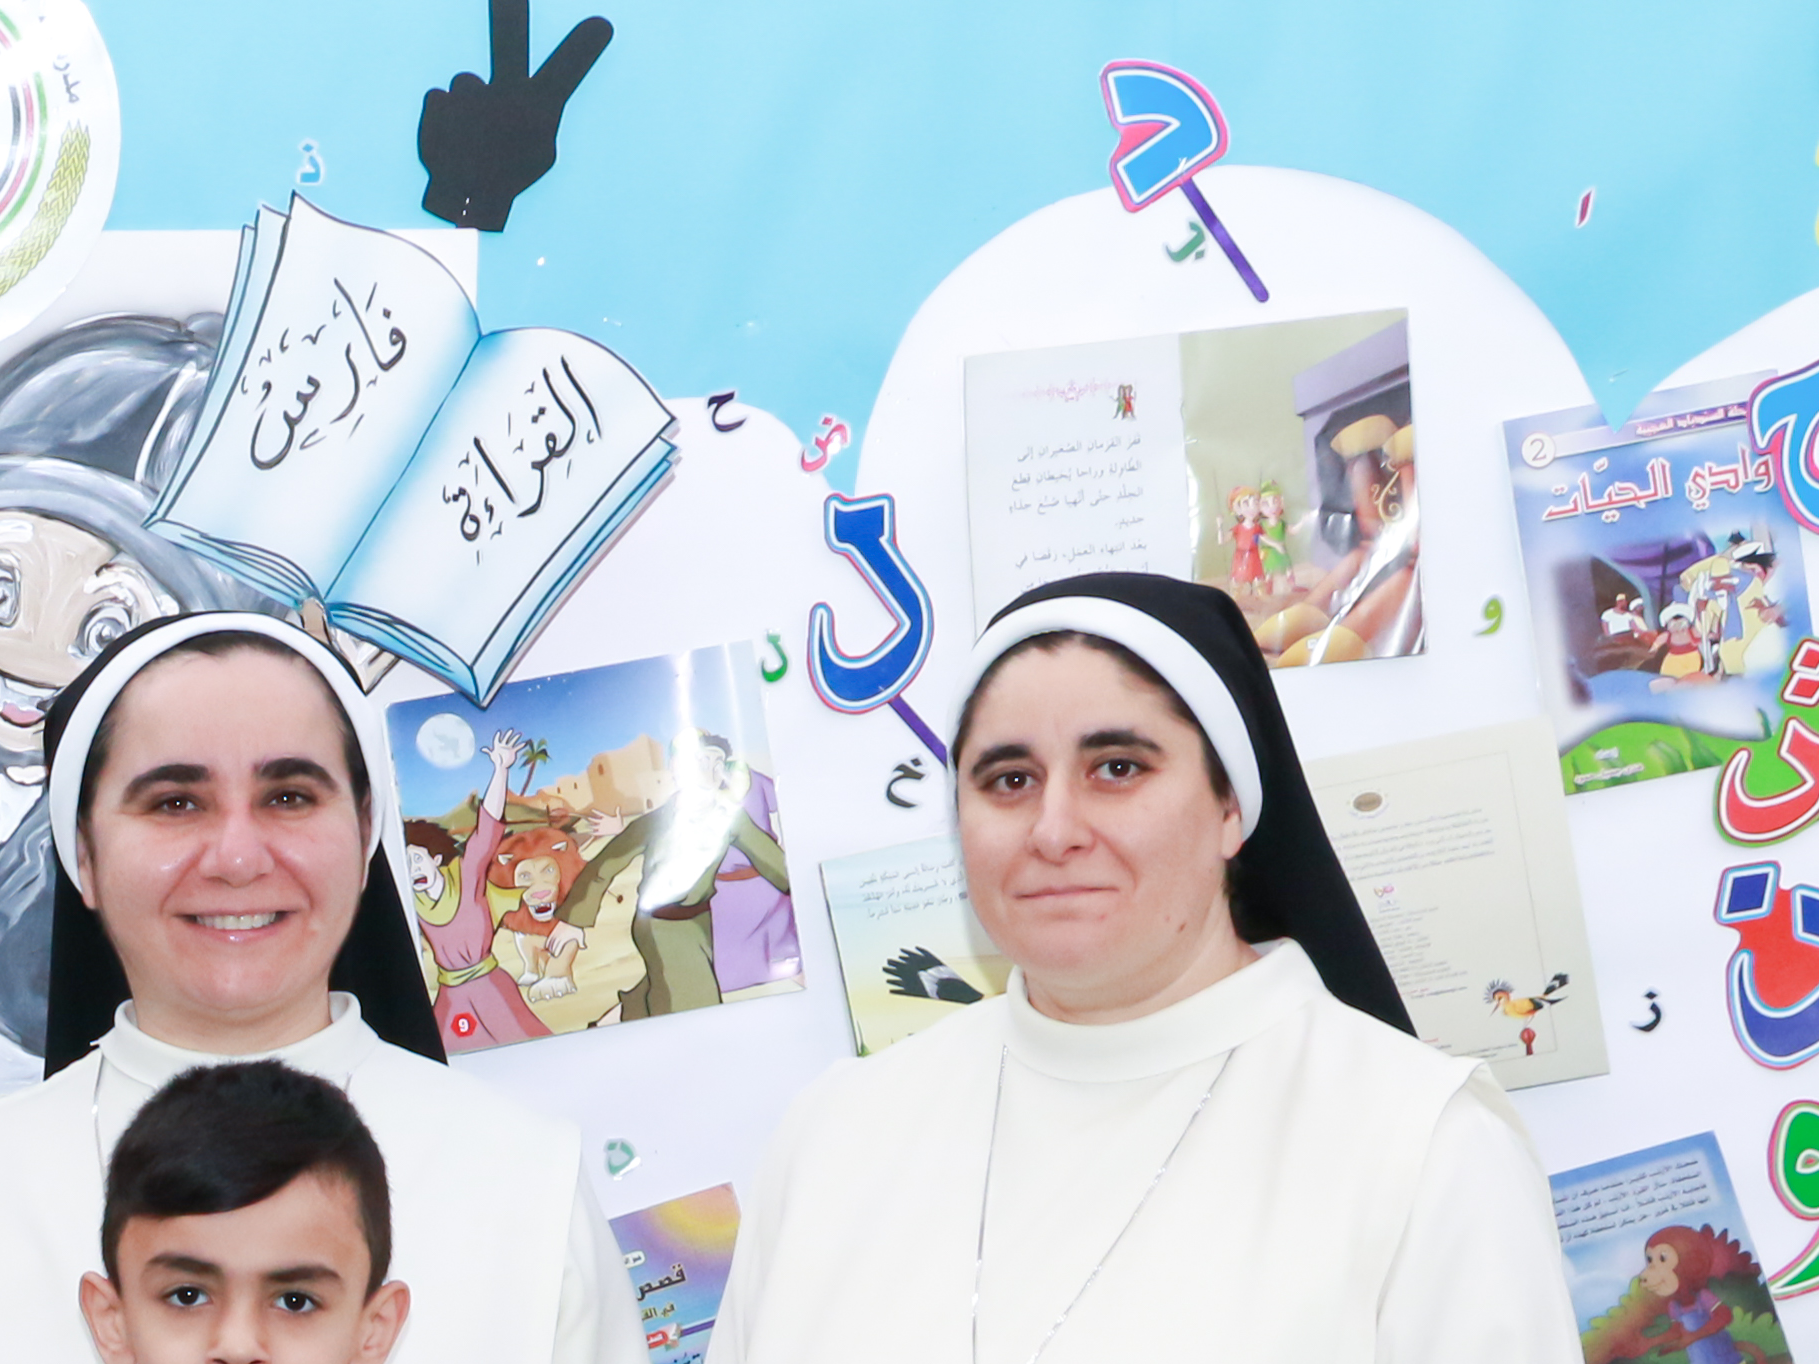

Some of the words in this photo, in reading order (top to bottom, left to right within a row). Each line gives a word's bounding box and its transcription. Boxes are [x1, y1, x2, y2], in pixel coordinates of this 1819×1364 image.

[1529, 438, 1547, 462] 2
[1685, 443, 1776, 511] وادي
[1474, 596, 1504, 636] و
[886, 756, 927, 809] خ
[457, 1018, 470, 1033] 9
[1630, 988, 1663, 1033] ز
